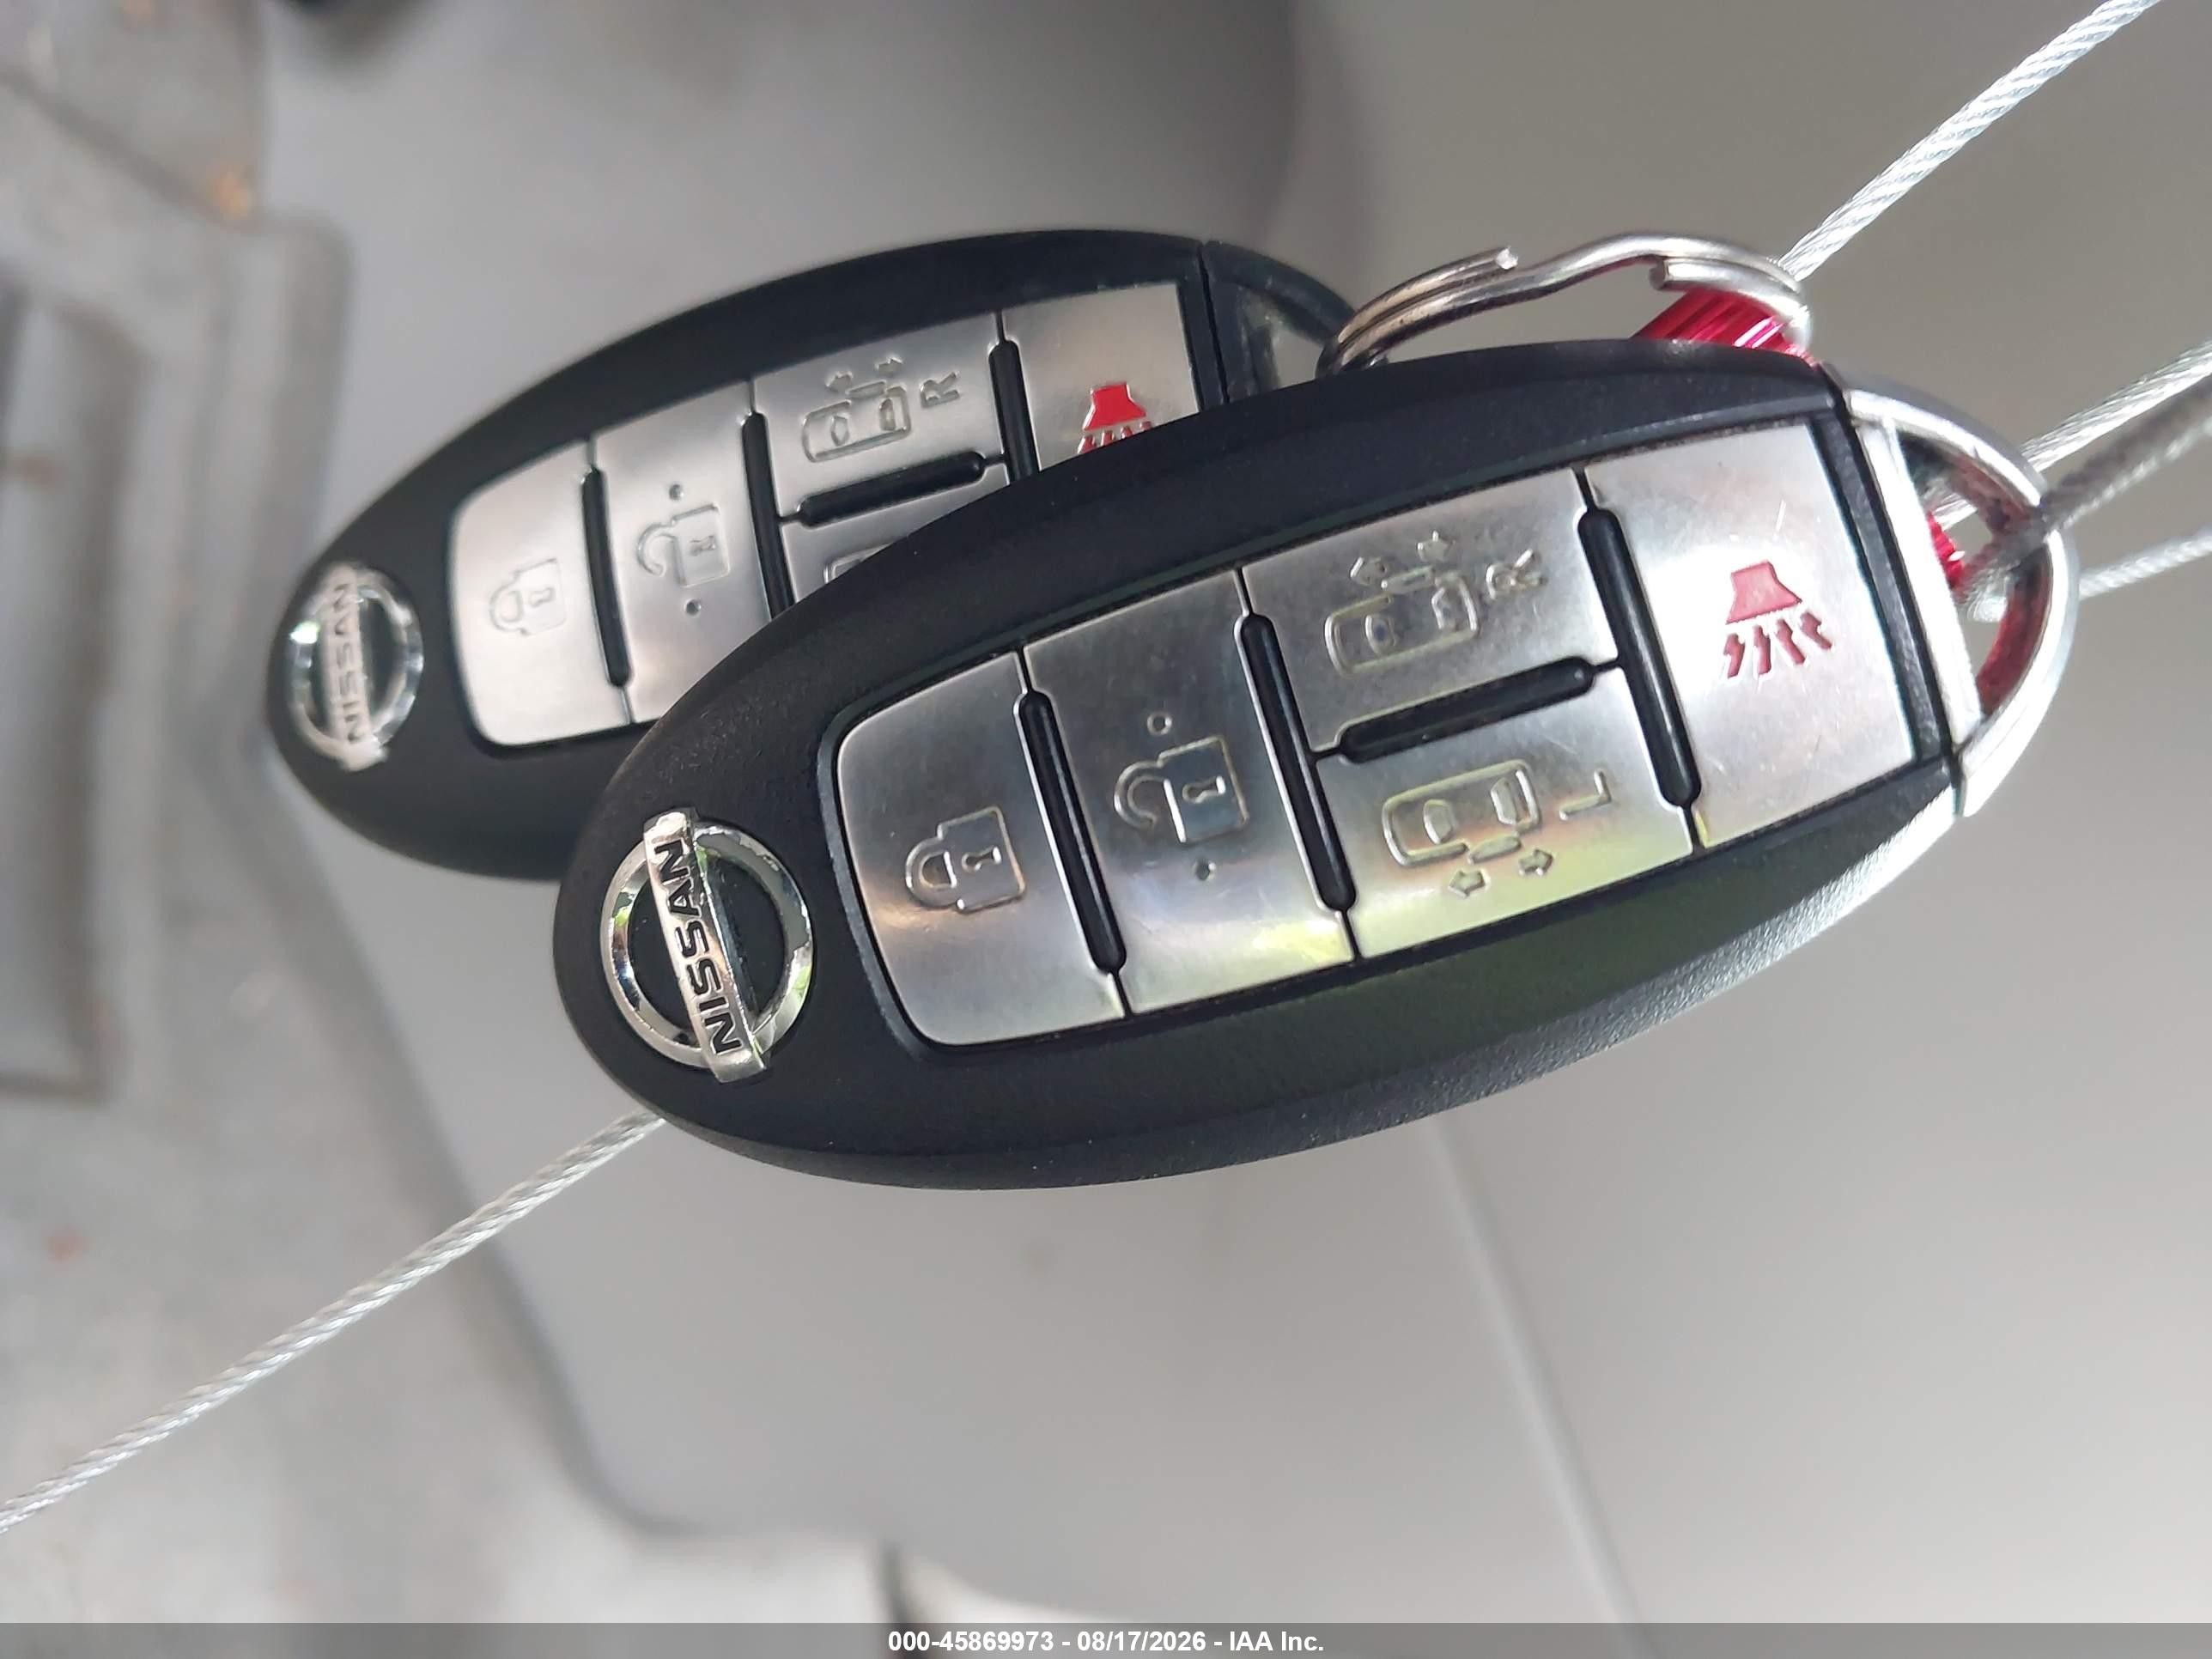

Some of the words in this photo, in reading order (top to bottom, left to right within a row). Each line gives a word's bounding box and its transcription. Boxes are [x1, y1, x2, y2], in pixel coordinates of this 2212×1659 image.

[919, 371, 960, 409] R
[1486, 548, 1544, 599] R
[332, 582, 363, 743] NISSAN
[1559, 769, 1612, 822] L
[654, 838, 743, 1055] NISSAN
